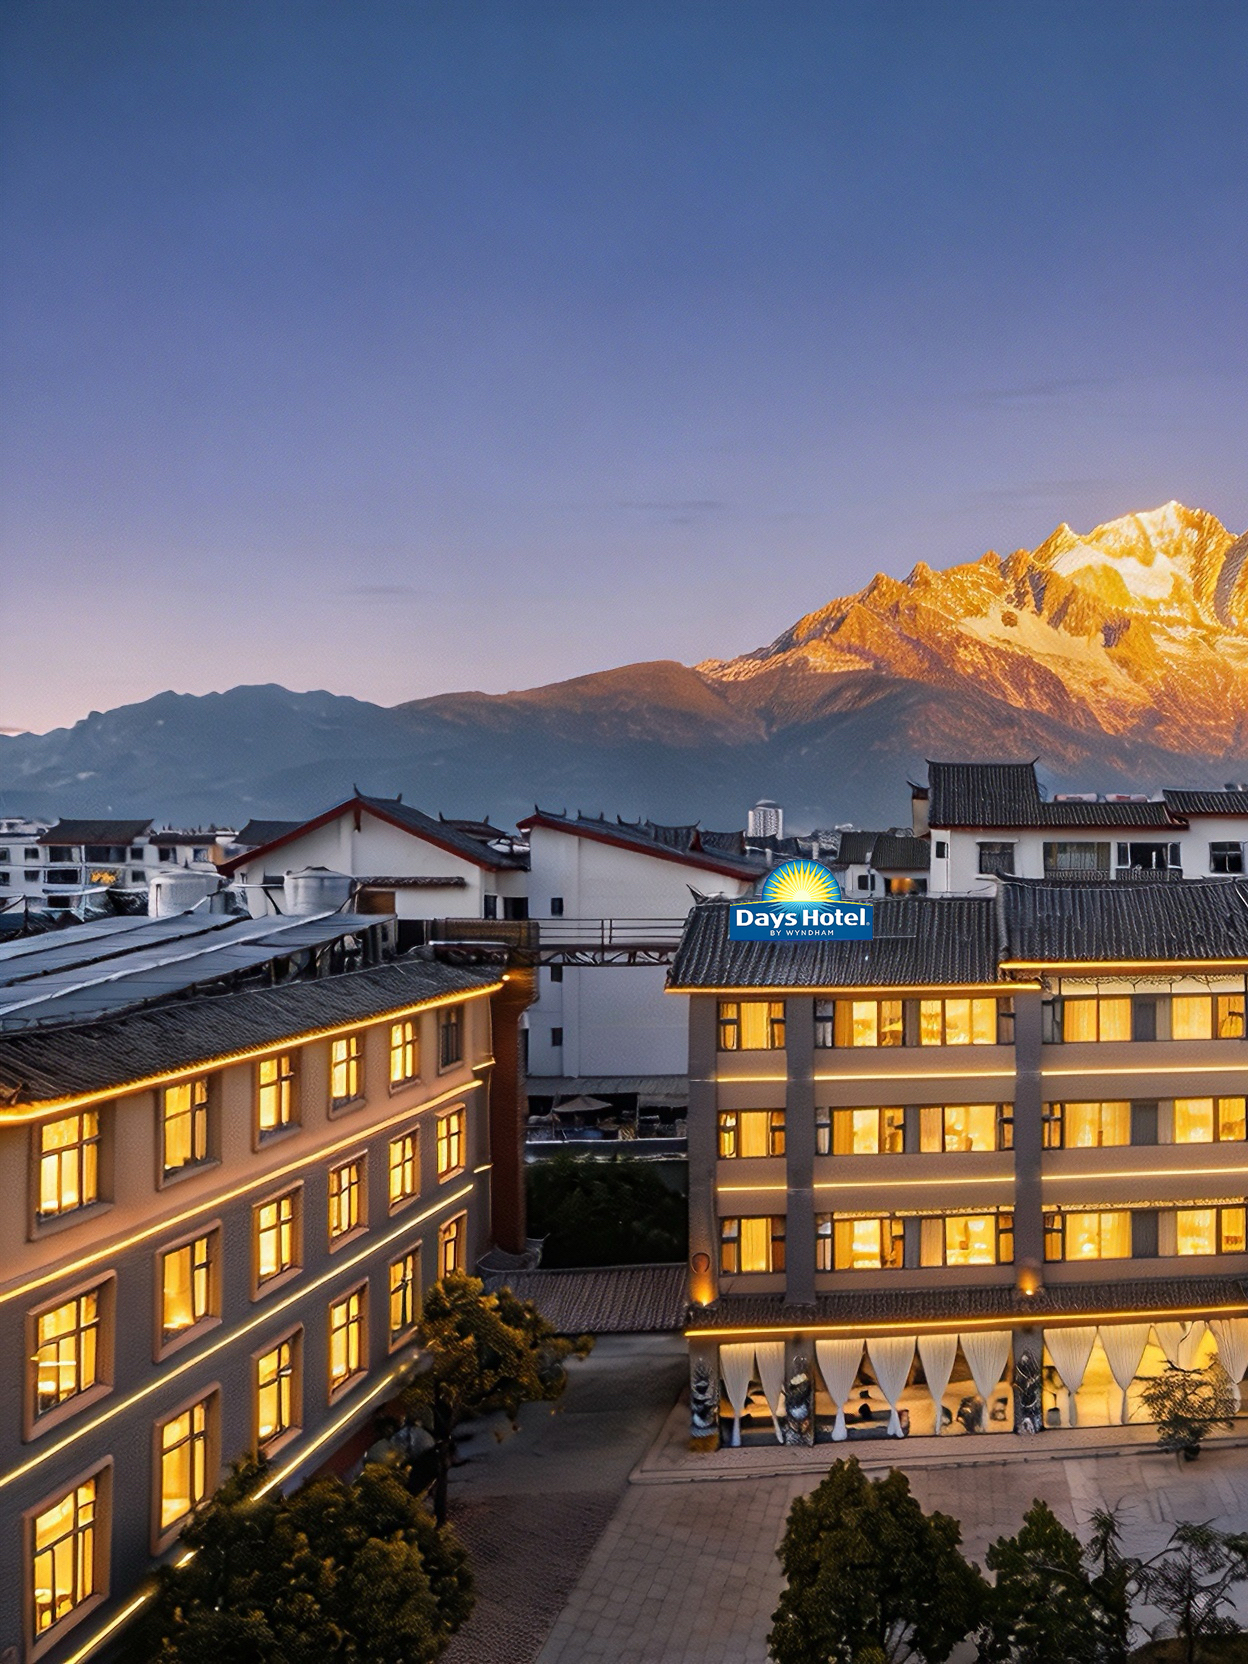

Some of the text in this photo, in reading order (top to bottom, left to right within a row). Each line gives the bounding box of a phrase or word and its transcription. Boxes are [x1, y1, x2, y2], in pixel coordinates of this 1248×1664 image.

[736, 908, 866, 929] Days Hotel
[769, 929, 782, 937] BY
